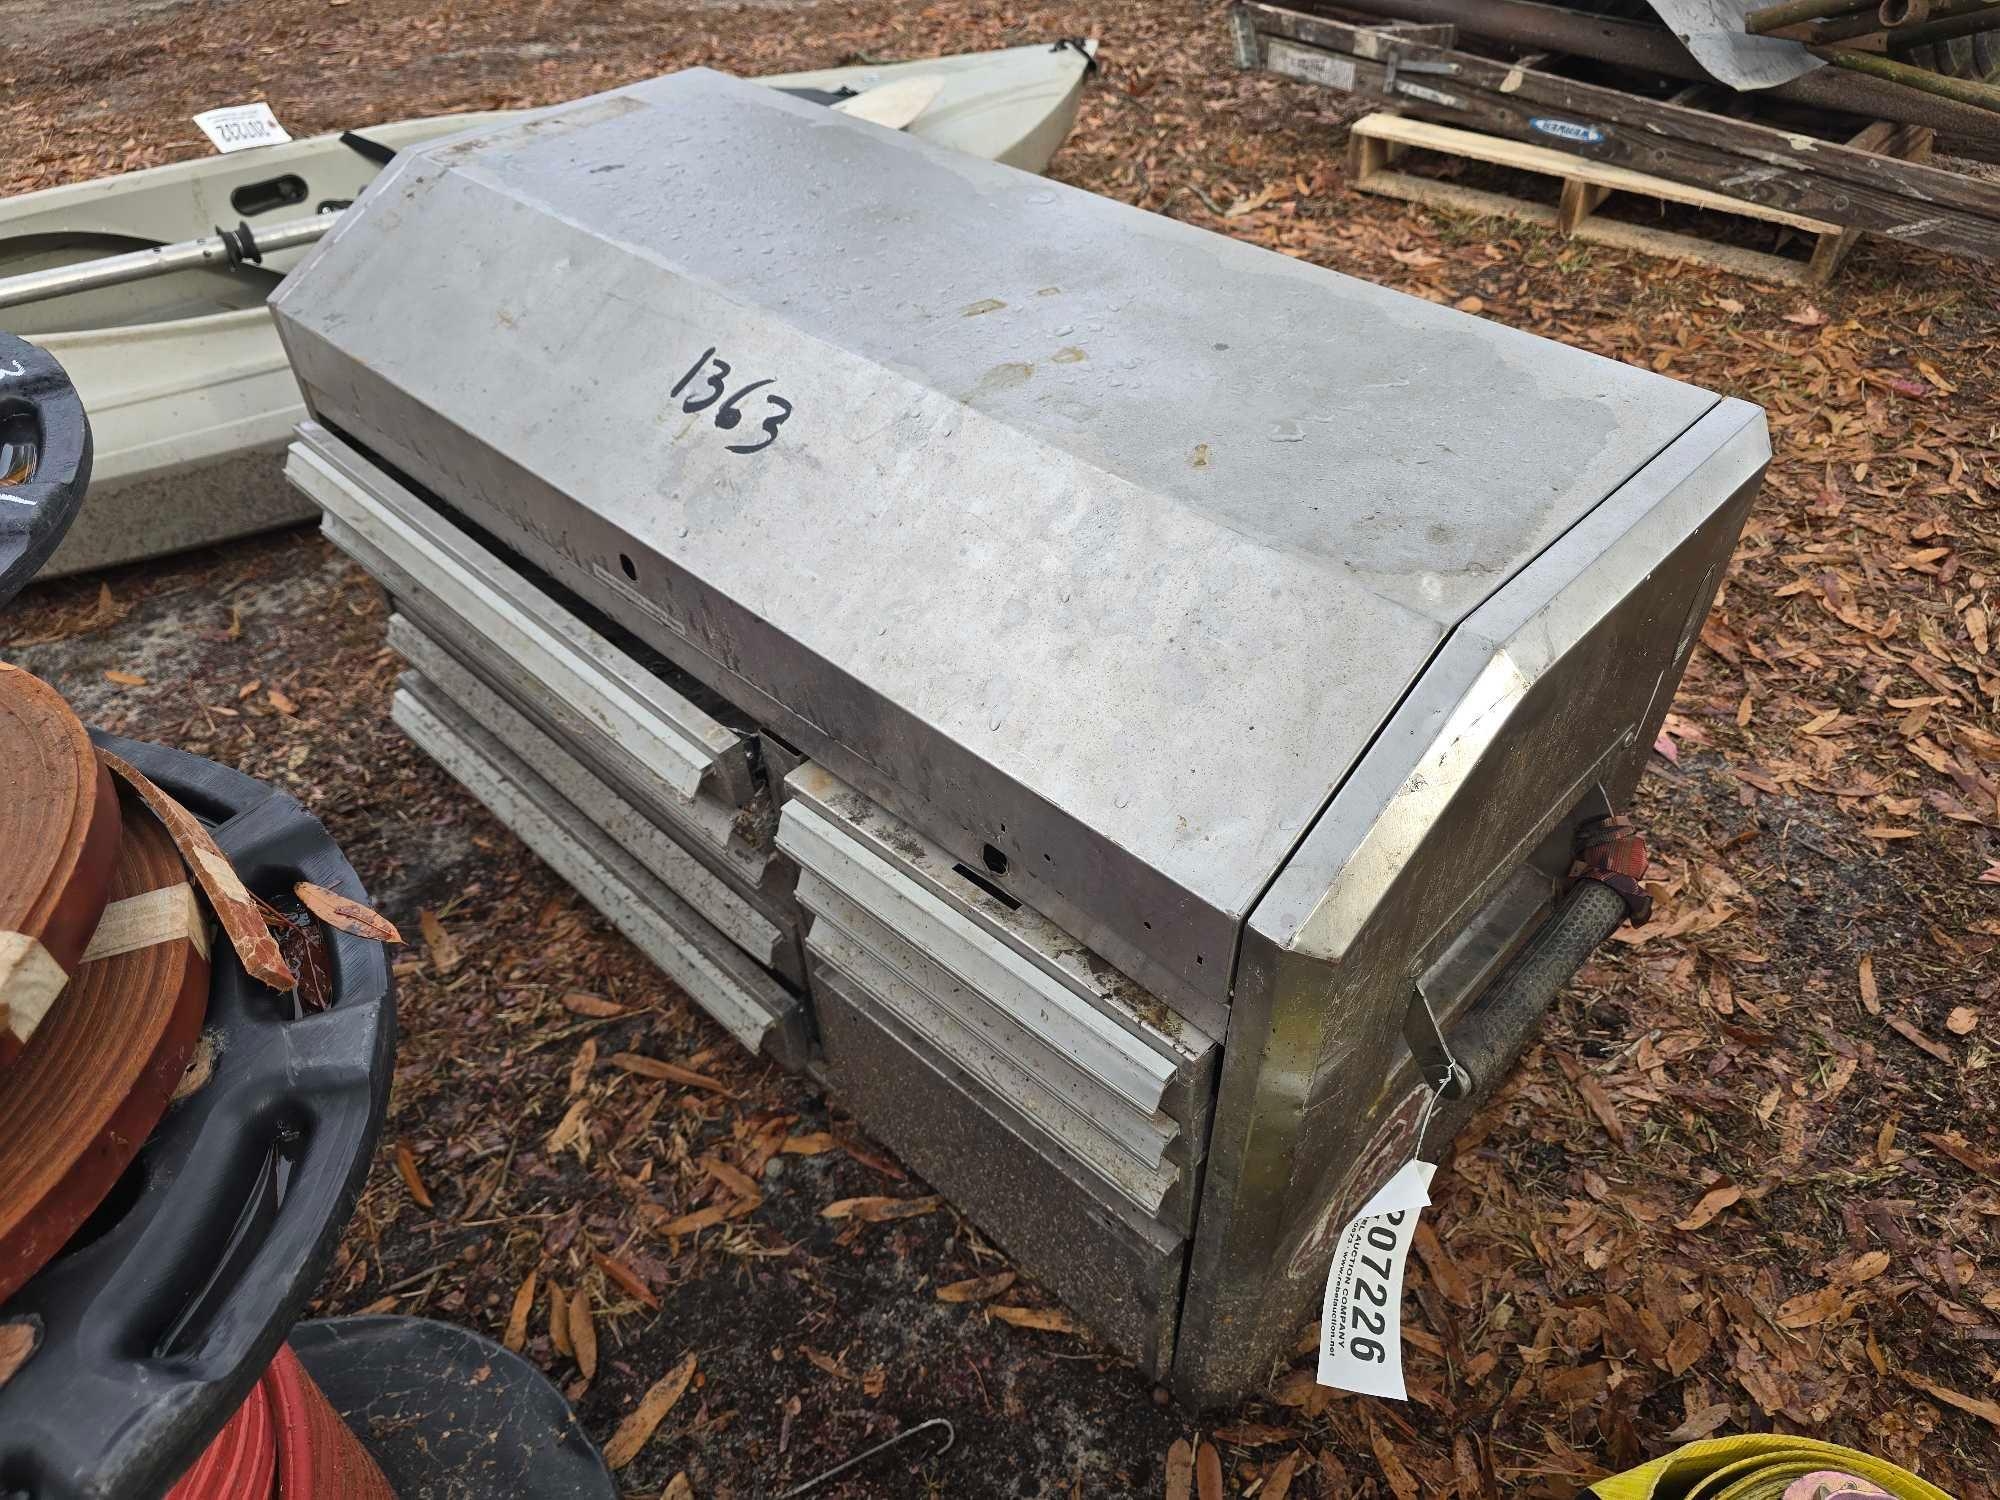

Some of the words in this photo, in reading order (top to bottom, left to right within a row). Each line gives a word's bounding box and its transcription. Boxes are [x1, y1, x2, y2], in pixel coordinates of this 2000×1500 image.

[671, 347, 793, 454] 1363
[1345, 1234, 1361, 1285] AUCTION
[1329, 1252, 1348, 1357] www.rebelauction.net
[1338, 1288, 1349, 1349] COMPANY
